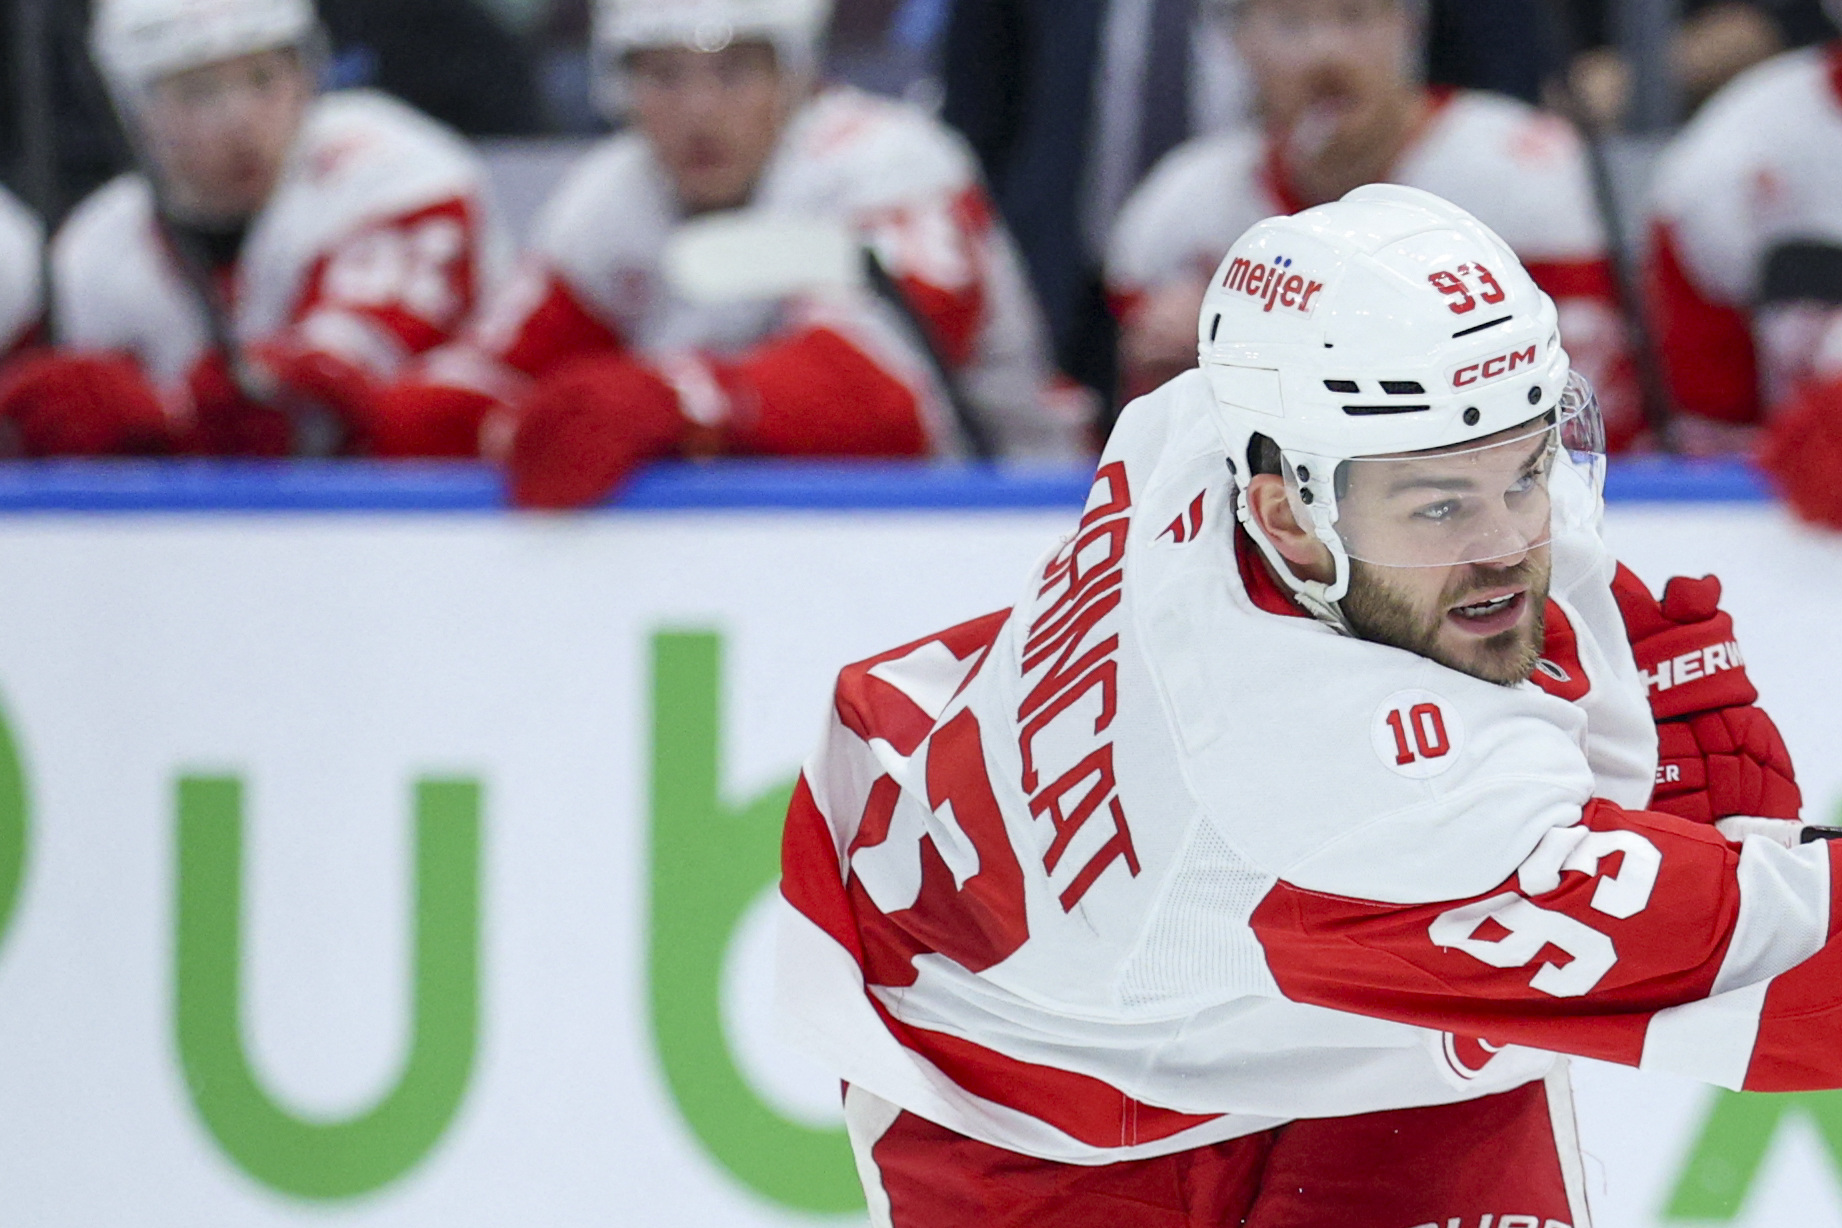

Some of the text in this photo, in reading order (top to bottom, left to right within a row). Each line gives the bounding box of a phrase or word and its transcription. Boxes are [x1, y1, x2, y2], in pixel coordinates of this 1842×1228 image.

[1221, 255, 1324, 313] meijer
[1427, 261, 1506, 315] 93
[1452, 344, 1538, 389] CCM
[1385, 702, 1450, 766] 10
[1428, 825, 1664, 1000] 93
